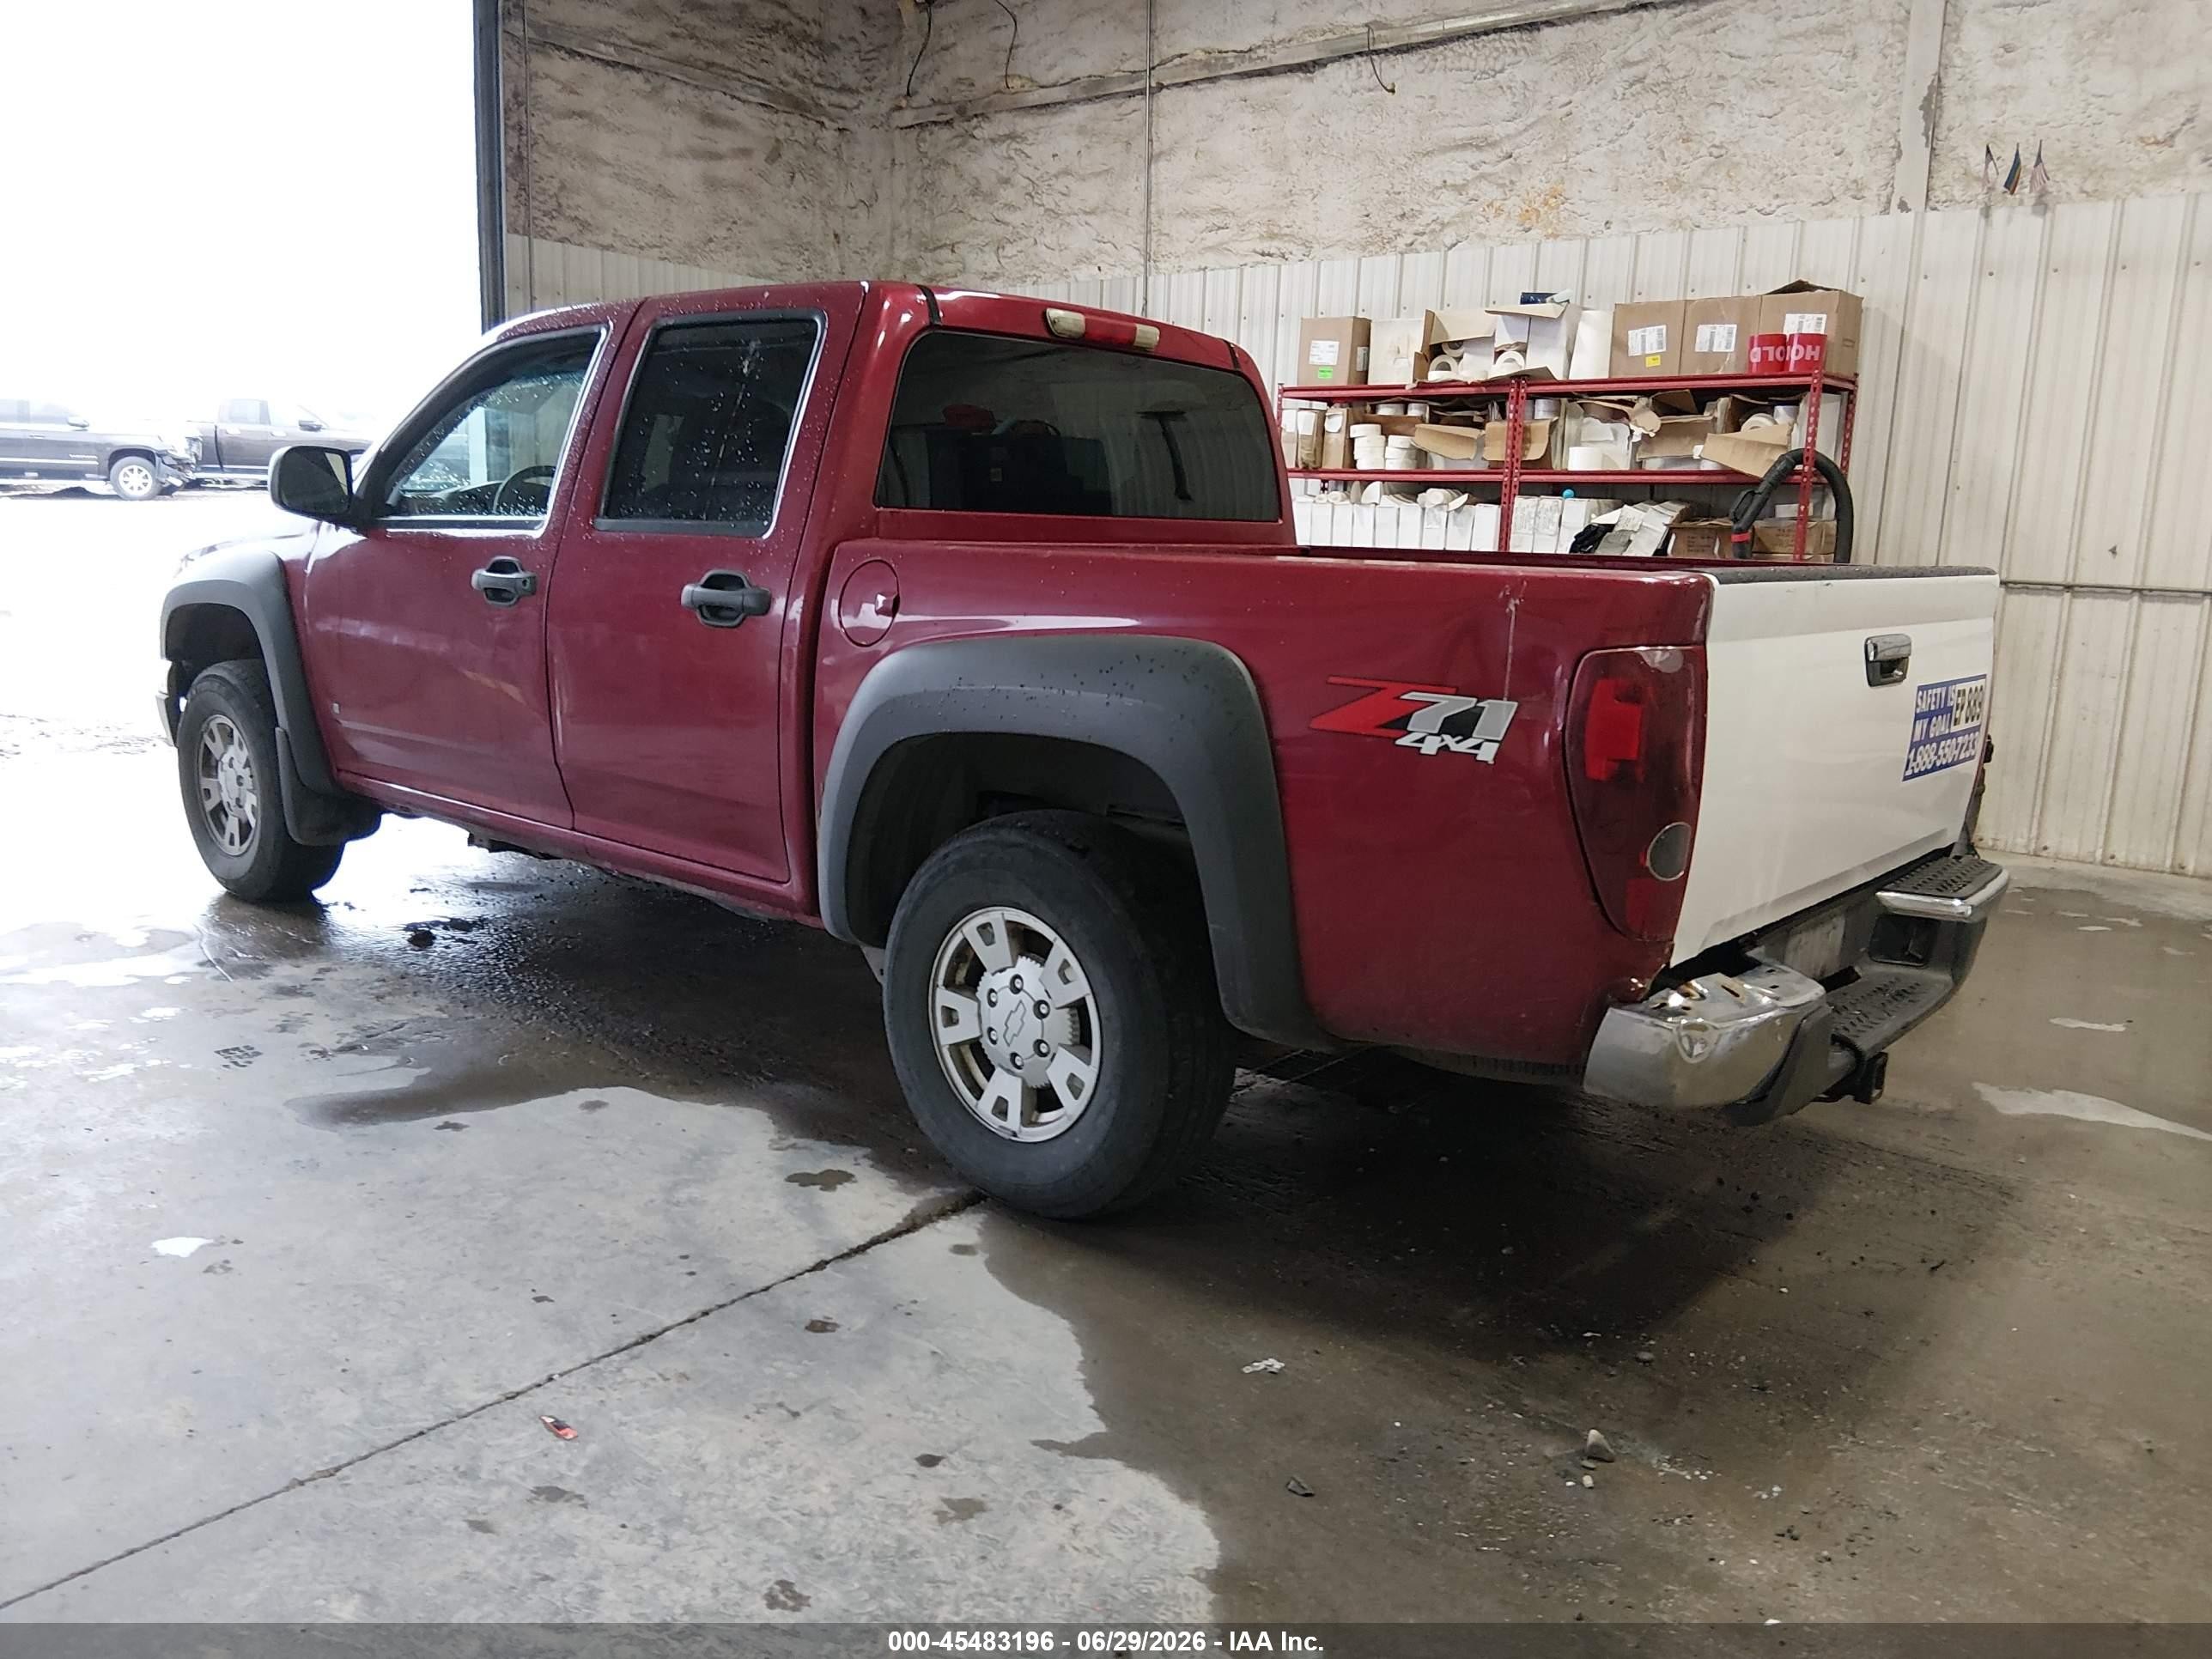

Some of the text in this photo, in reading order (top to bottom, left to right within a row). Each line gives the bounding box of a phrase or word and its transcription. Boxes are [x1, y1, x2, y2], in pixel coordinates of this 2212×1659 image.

[1310, 676, 1518, 741] Z71
[1917, 686, 1946, 714] SAFETY
[1954, 689, 1966, 726] EP
[1913, 714, 1951, 743] MY GOAL
